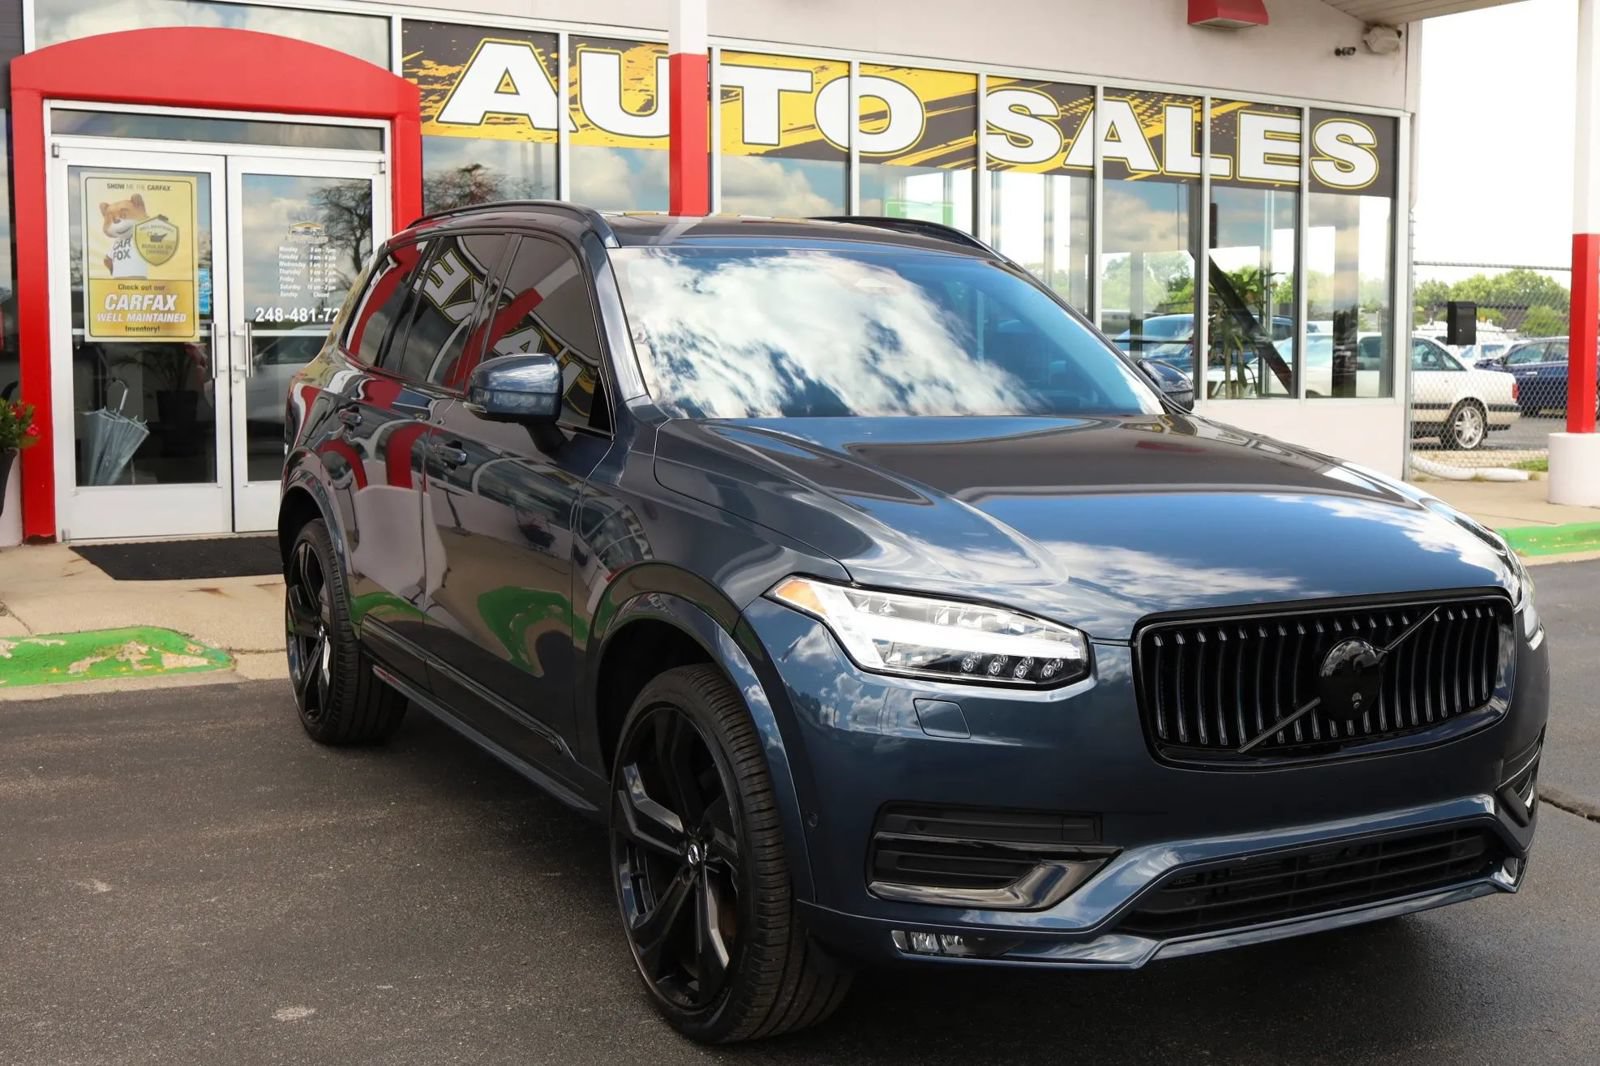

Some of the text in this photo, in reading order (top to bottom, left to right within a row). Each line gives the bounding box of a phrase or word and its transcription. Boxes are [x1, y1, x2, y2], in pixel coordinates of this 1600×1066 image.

[435, 38, 1380, 190] AUTO SALES
[113, 250, 132, 261] FOX
[104, 293, 178, 311] CARFAX
[97, 313, 187, 323] WELL MAINTAINED
[255, 307, 341, 322] 248-481-72
